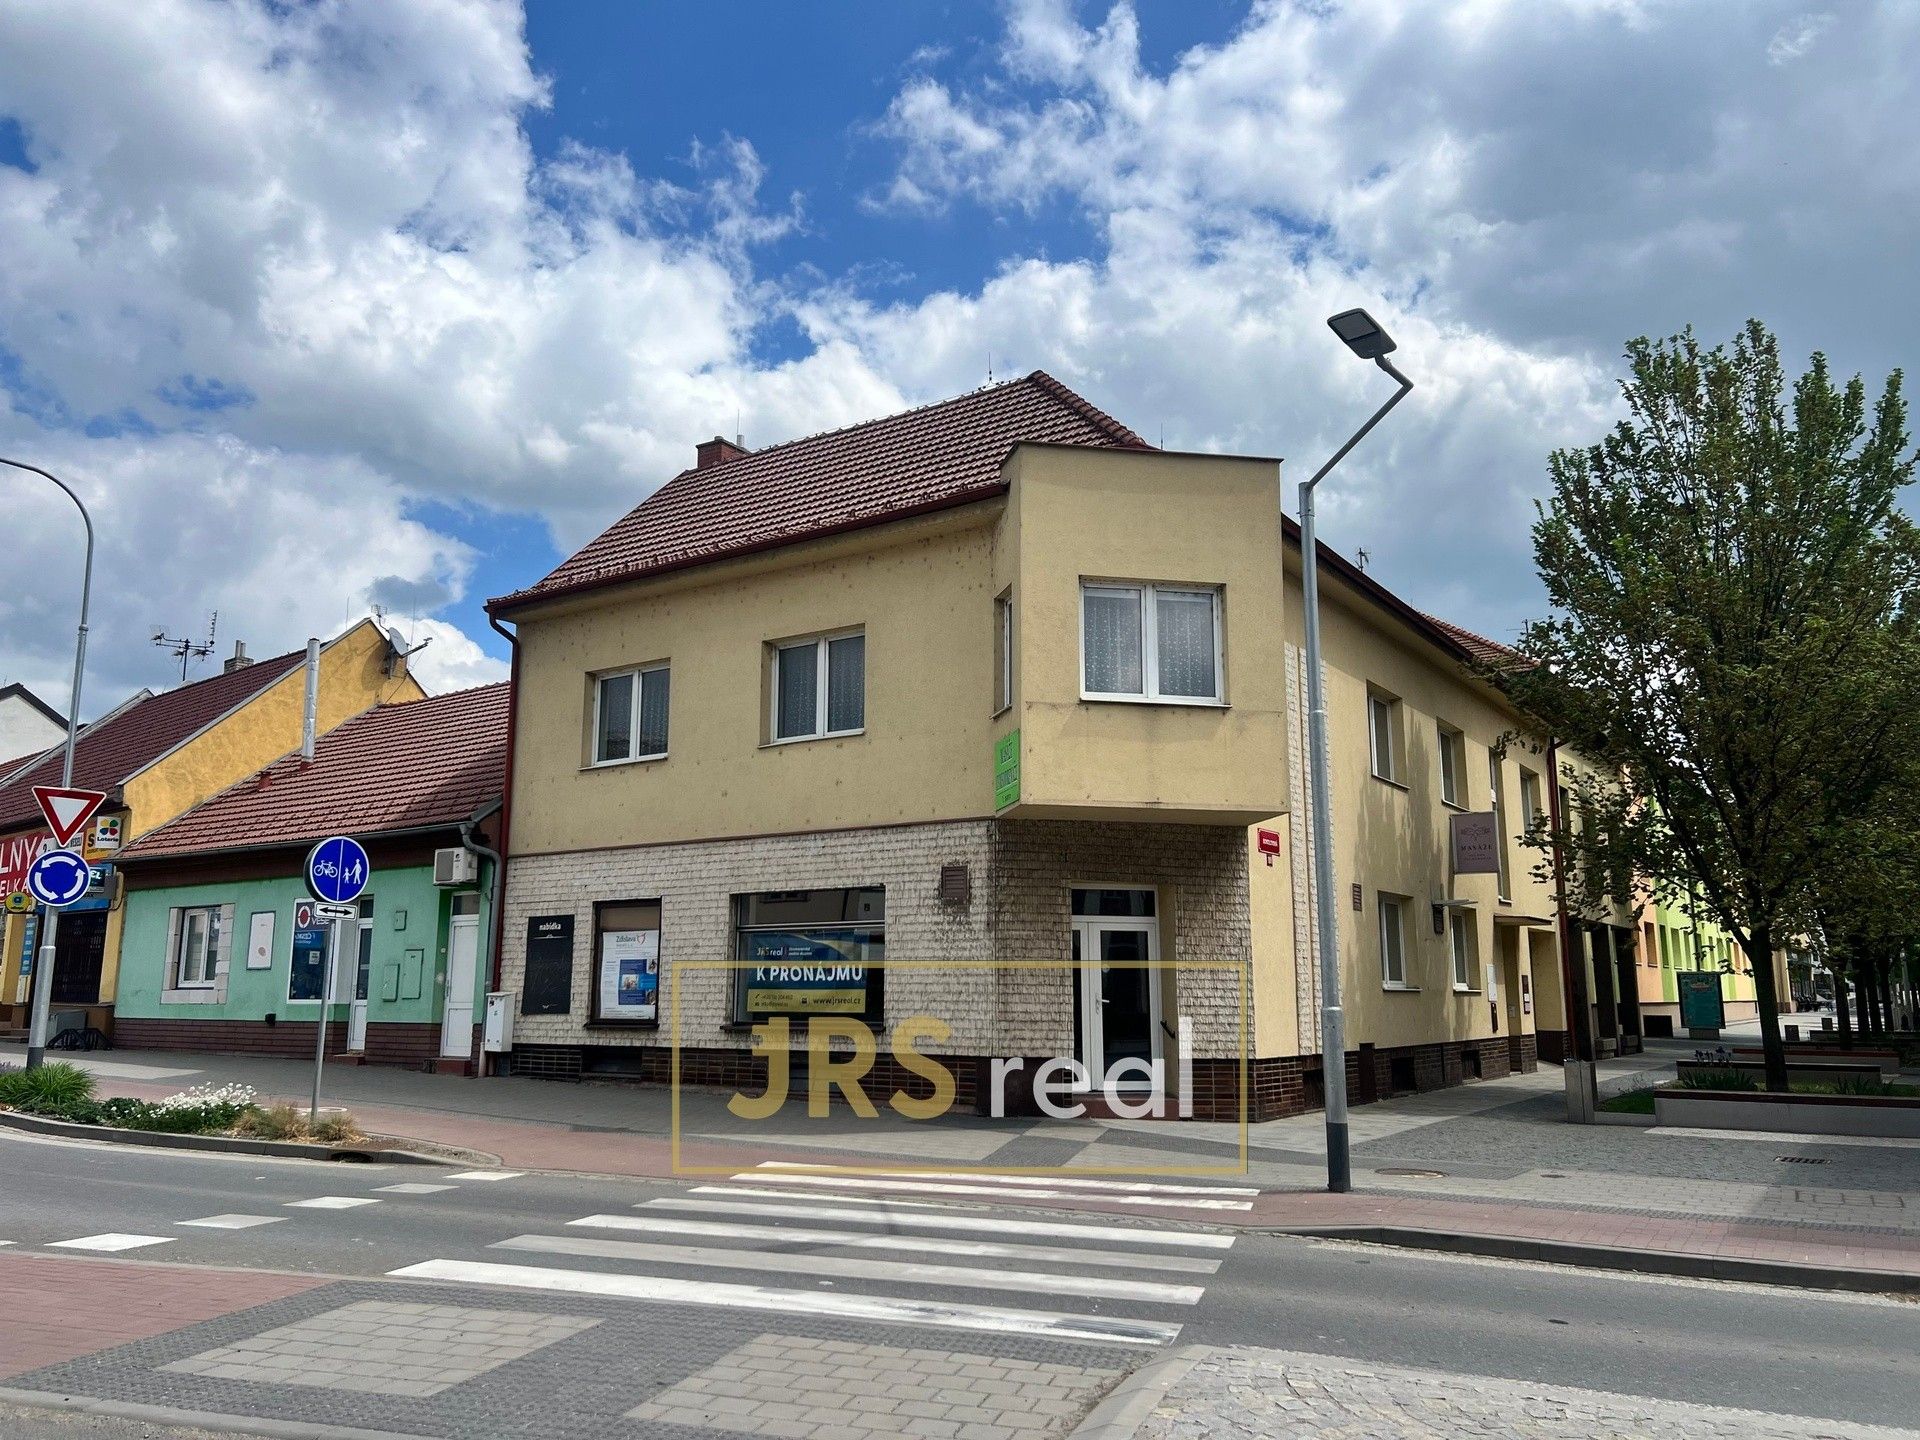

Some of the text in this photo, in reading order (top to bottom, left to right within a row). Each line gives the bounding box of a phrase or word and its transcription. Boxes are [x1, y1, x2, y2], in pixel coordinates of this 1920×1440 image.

[539, 922, 561, 931] nabídka
[770, 946, 783, 957] real
[756, 961, 863, 981] K PRONÁJMU
[813, 996, 861, 1006] www.jrsreal.cz
